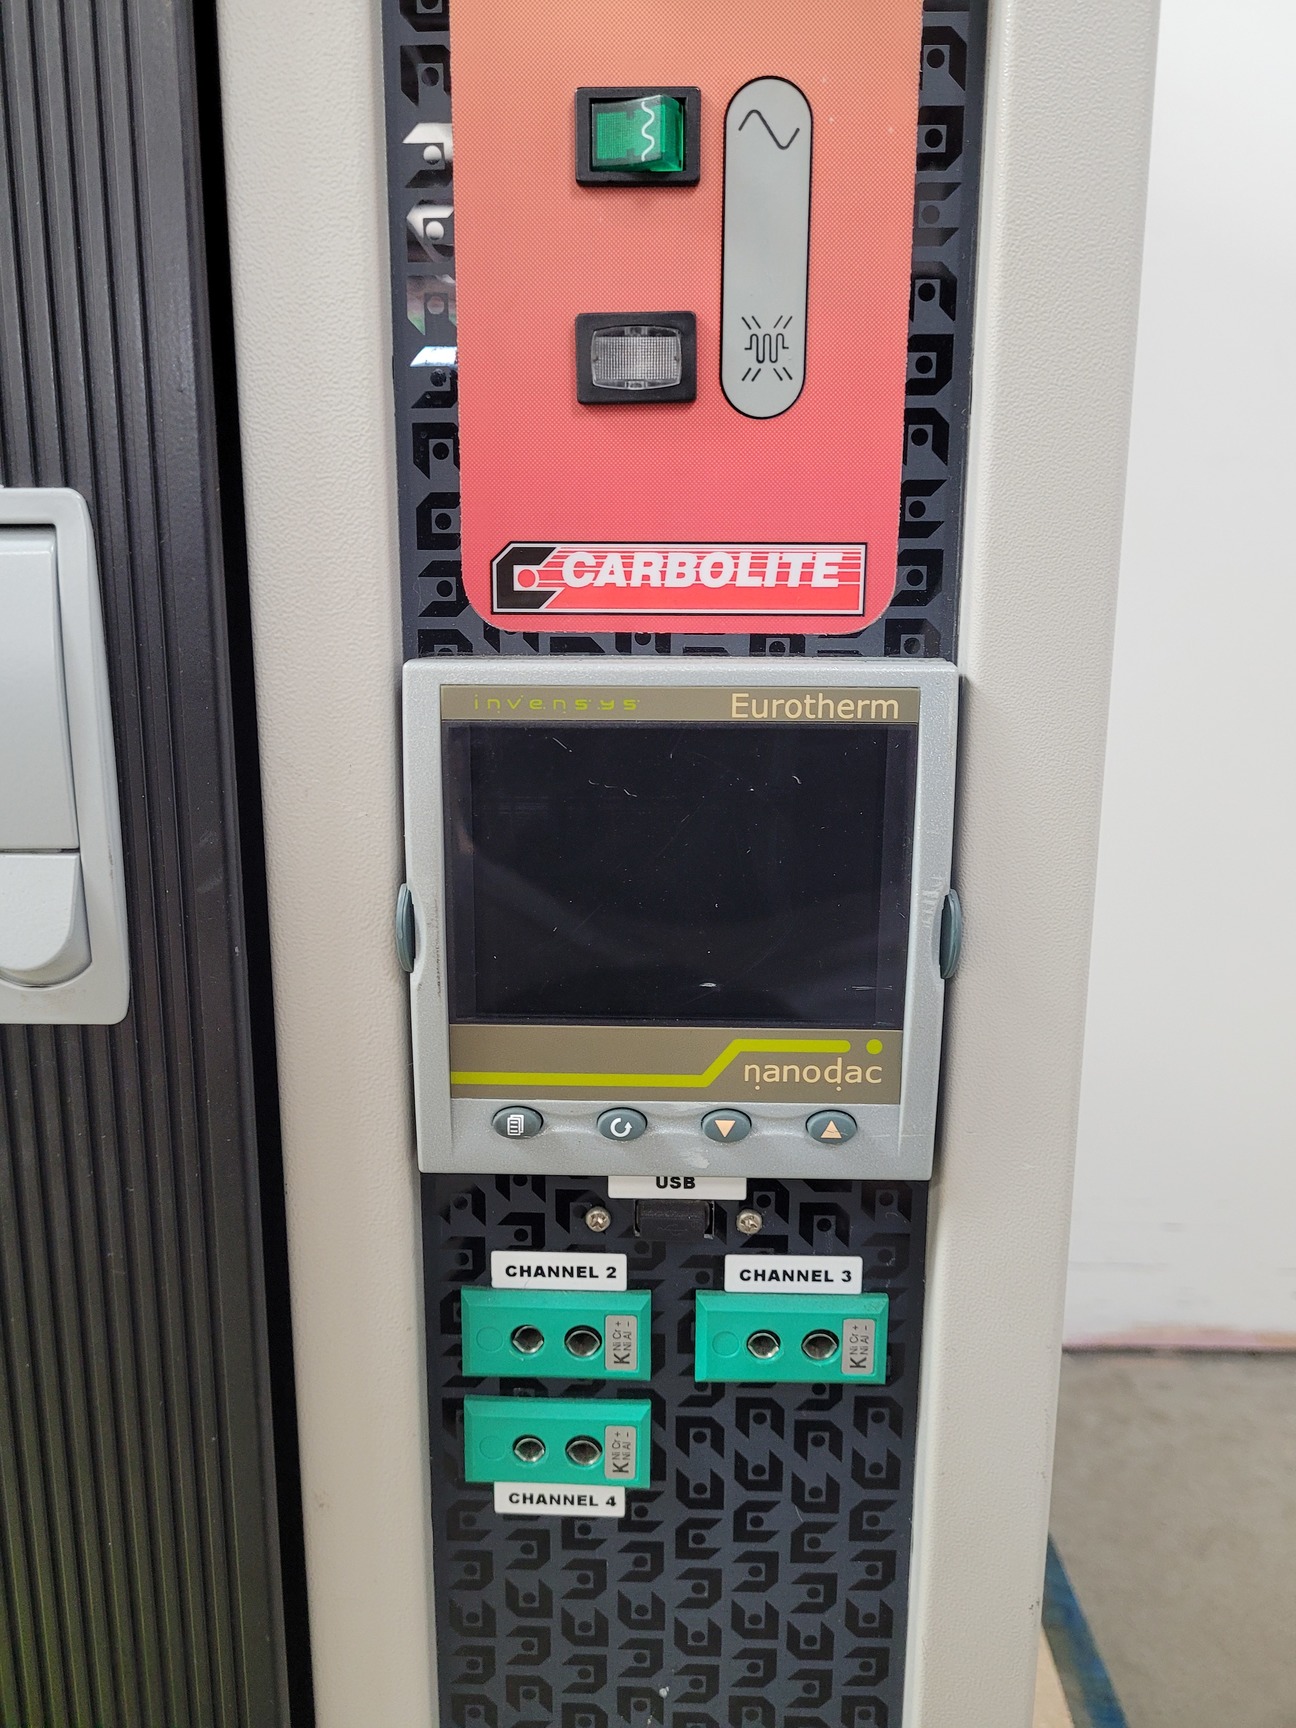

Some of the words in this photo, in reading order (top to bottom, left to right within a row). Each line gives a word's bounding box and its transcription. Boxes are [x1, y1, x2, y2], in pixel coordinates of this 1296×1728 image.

[562, 551, 844, 588] CARBOLITE
[473, 693, 639, 713] invensys
[731, 692, 899, 720] Eurotherm
[656, 1176, 696, 1189] USB
[505, 1265, 599, 1278] CHANNEL
[606, 1266, 617, 1278] 2
[739, 1269, 834, 1282] CHANNEL
[841, 1270, 852, 1282] 3
[613, 1353, 630, 1364] K
[849, 1357, 867, 1368] K
[612, 1462, 629, 1473] K
[508, 1493, 599, 1506] CHANNEL
[605, 1496, 617, 1507] 4
